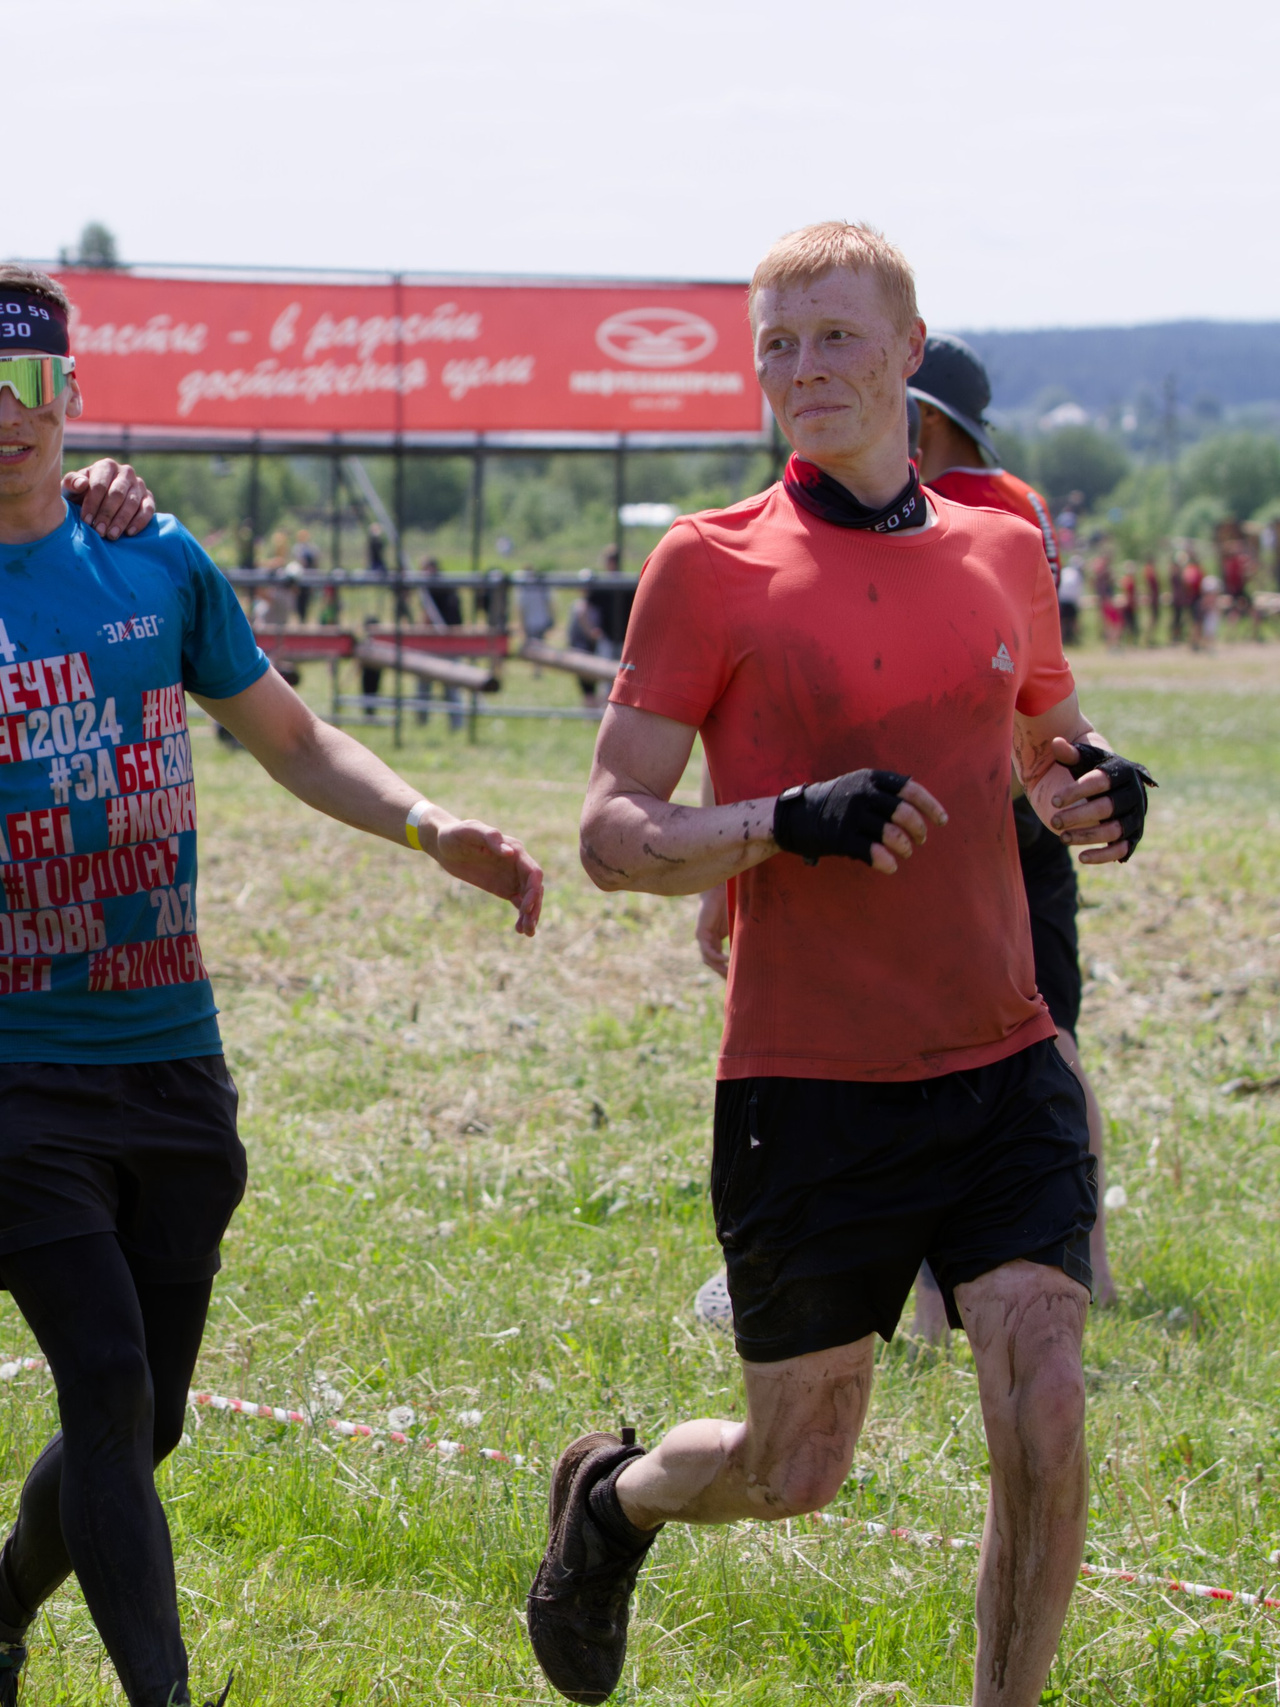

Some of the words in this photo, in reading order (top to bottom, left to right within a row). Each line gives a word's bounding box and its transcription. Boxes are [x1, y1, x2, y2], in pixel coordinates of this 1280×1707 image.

[28, 305, 51, 321] 59
[303, 302, 483, 361] радости
[870, 514, 900, 532] ЕО
[902, 496, 916, 518] 59
[142, 682, 189, 740] #ЦЕ
[88, 932, 210, 992] #ЕДИНСТ
